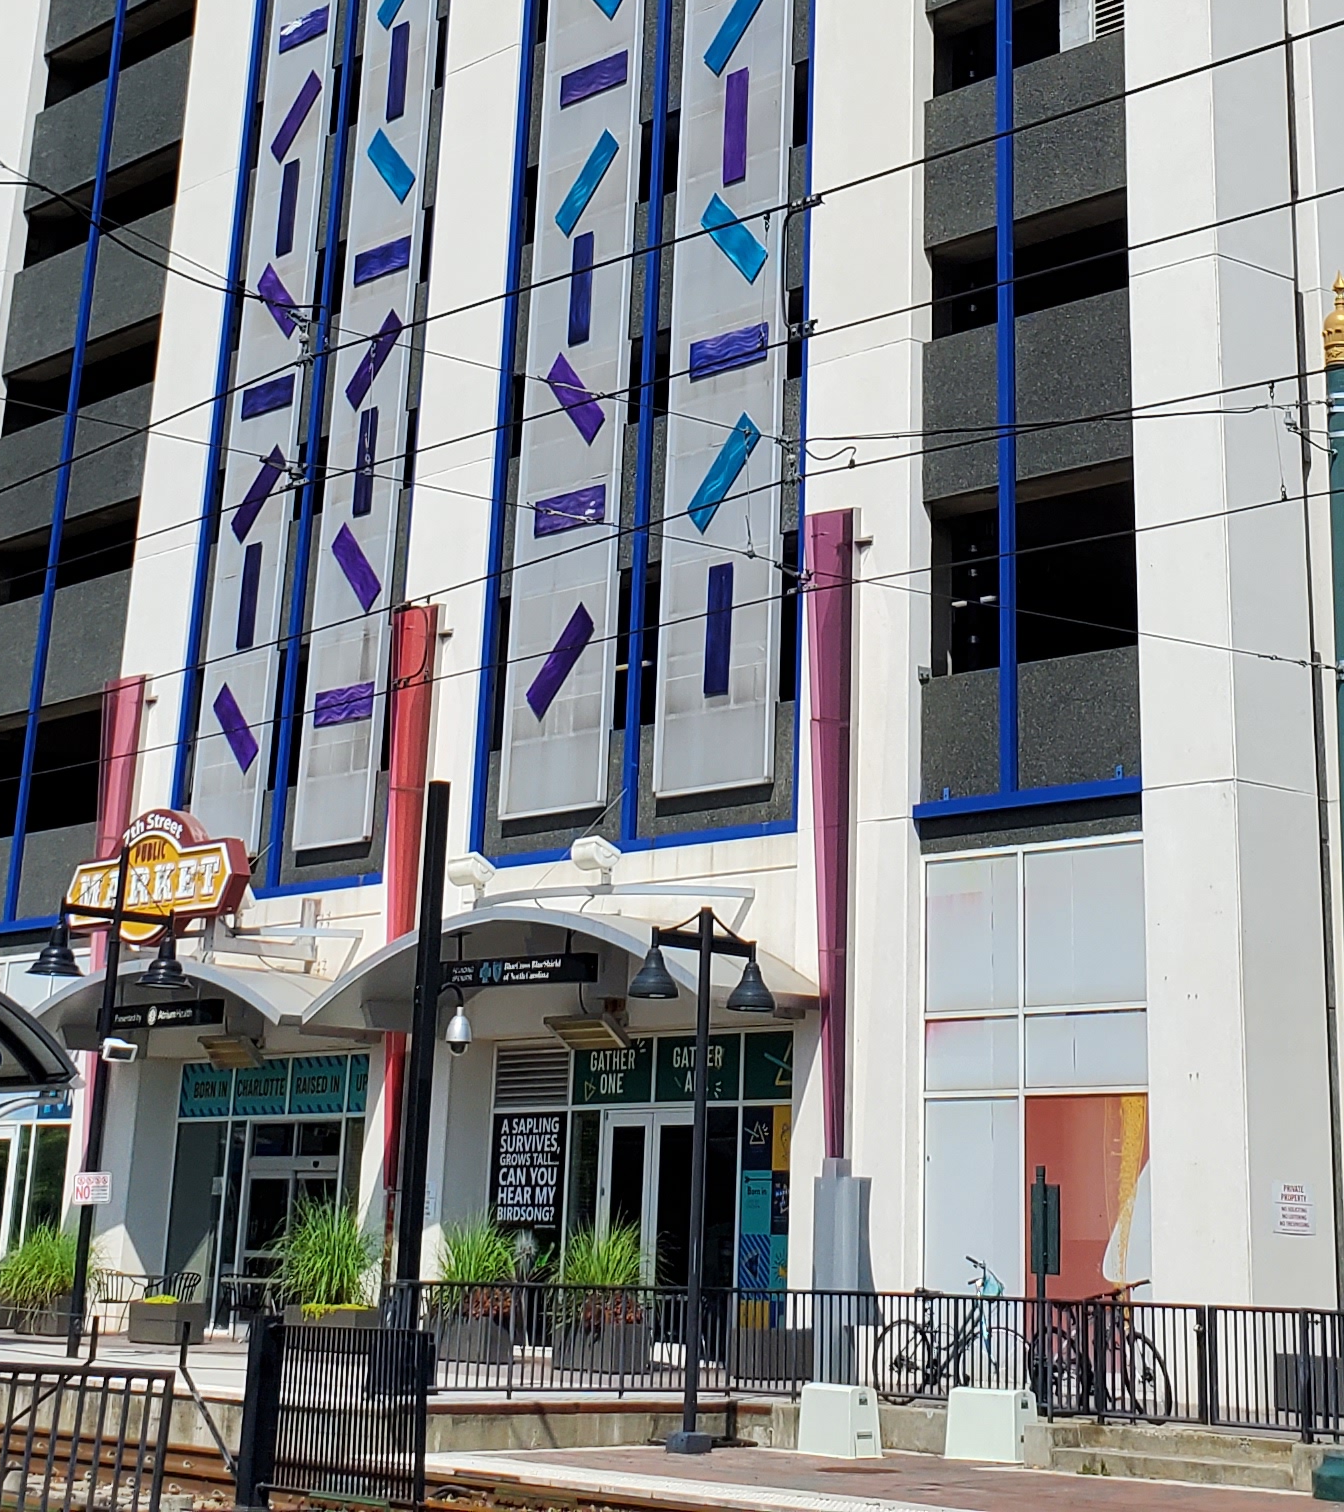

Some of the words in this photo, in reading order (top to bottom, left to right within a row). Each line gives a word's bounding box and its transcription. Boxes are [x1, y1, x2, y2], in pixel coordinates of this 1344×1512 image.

[122, 819, 144, 846] 7th
[146, 814, 183, 839] Street
[135, 840, 166, 864] PUBLIC
[79, 856, 220, 907] MARKET
[590, 1049, 636, 1072] GATHER
[672, 1045, 723, 1068] GATER
[193, 1080, 217, 1099] BORN
[218, 1079, 228, 1097] IN
[237, 1077, 286, 1097] CHARLOTTE
[295, 1075, 329, 1095] RAISED
[330, 1074, 340, 1092] IN
[599, 1073, 624, 1094] ONE
[501, 1118, 510, 1134] A
[512, 1117, 560, 1134] SAPLING
[499, 1134, 561, 1154] SURVIVES,
[499, 1153, 531, 1166] GROWS
[498, 1167, 527, 1186] CAN
[530, 1166, 558, 1185] YOU
[76, 1185, 91, 1200] NO
[497, 1187, 532, 1205] HEAR
[534, 1186, 557, 1205] MY
[1281, 1193, 1307, 1202] PROPERTY
[1283, 1184, 1304, 1193] PRIVATE
[497, 1206, 555, 1222] BIRDSONG?
